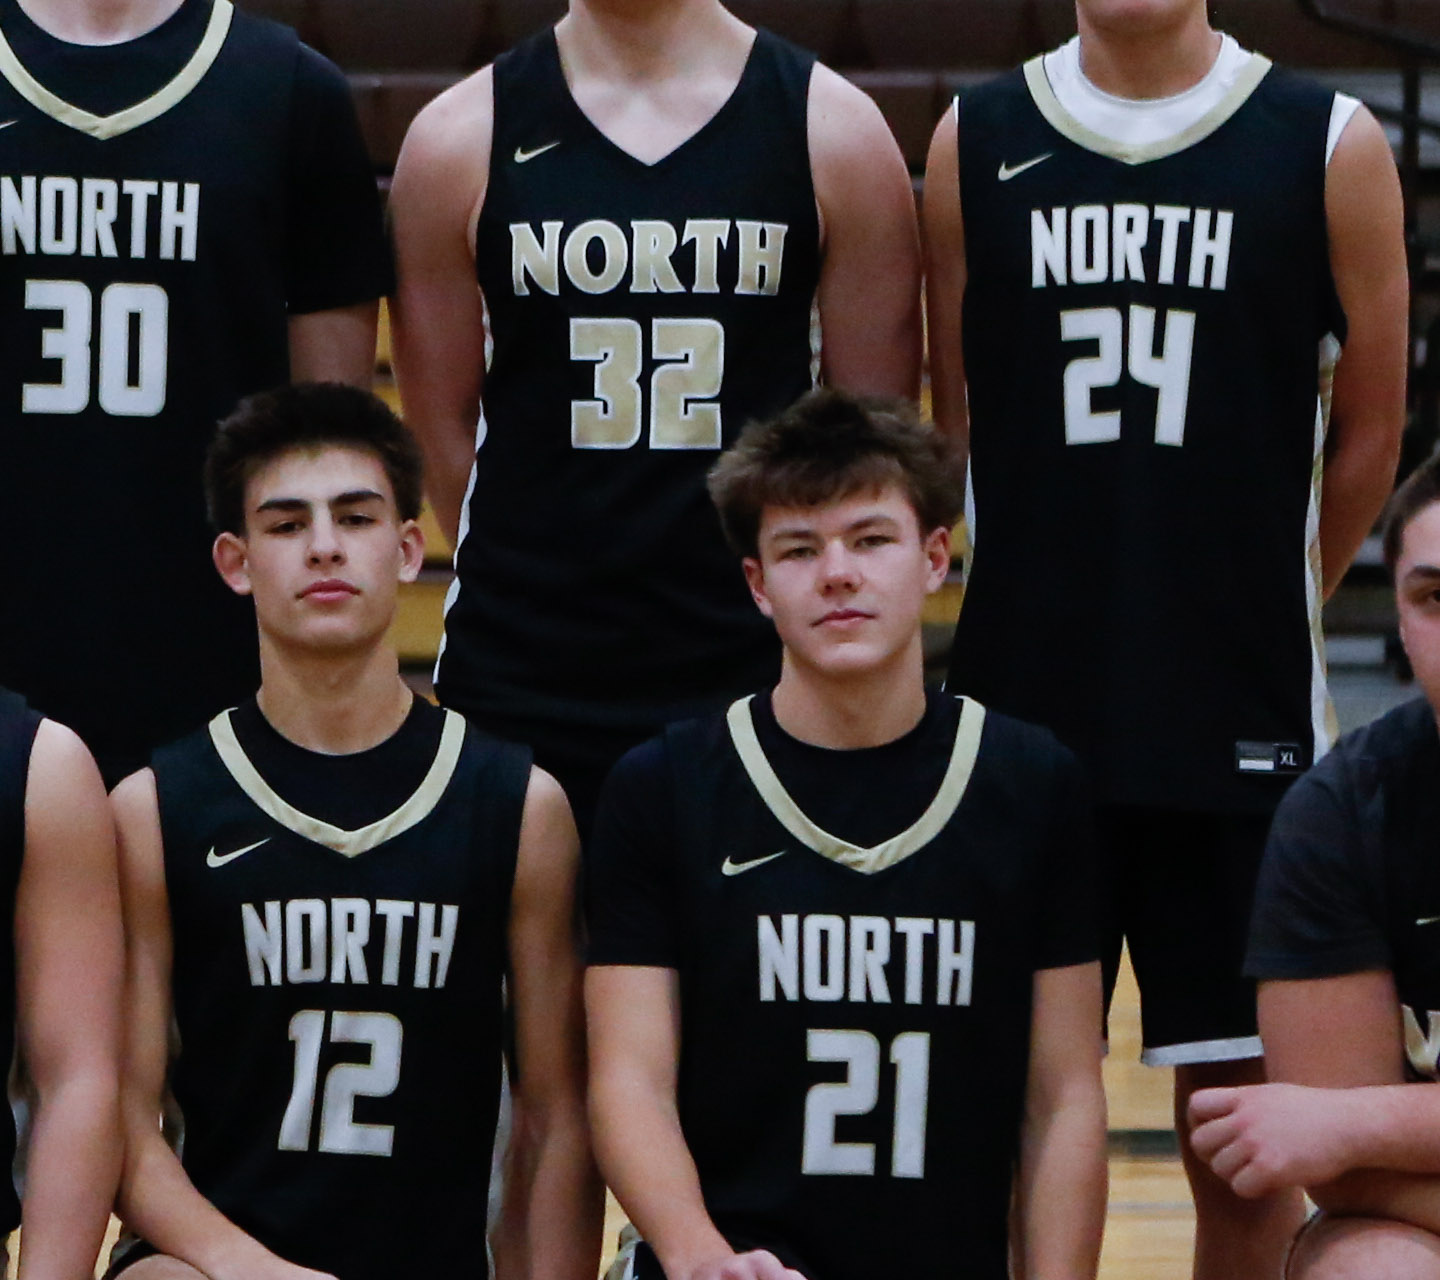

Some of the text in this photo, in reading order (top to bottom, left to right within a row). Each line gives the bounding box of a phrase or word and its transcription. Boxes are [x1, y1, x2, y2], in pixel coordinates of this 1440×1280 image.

[0, 176, 200, 261] NORTH
[509, 218, 788, 296] NORTH
[1031, 203, 1233, 290] NORTH
[22, 279, 169, 417] 30
[569, 317, 725, 449] 32
[1060, 304, 1196, 446] 24
[1280, 751, 1297, 766] XL
[242, 898, 459, 988] NORTH
[757, 914, 975, 1006] NORTH
[278, 1010, 403, 1157] 12
[801, 1029, 930, 1178] 21
